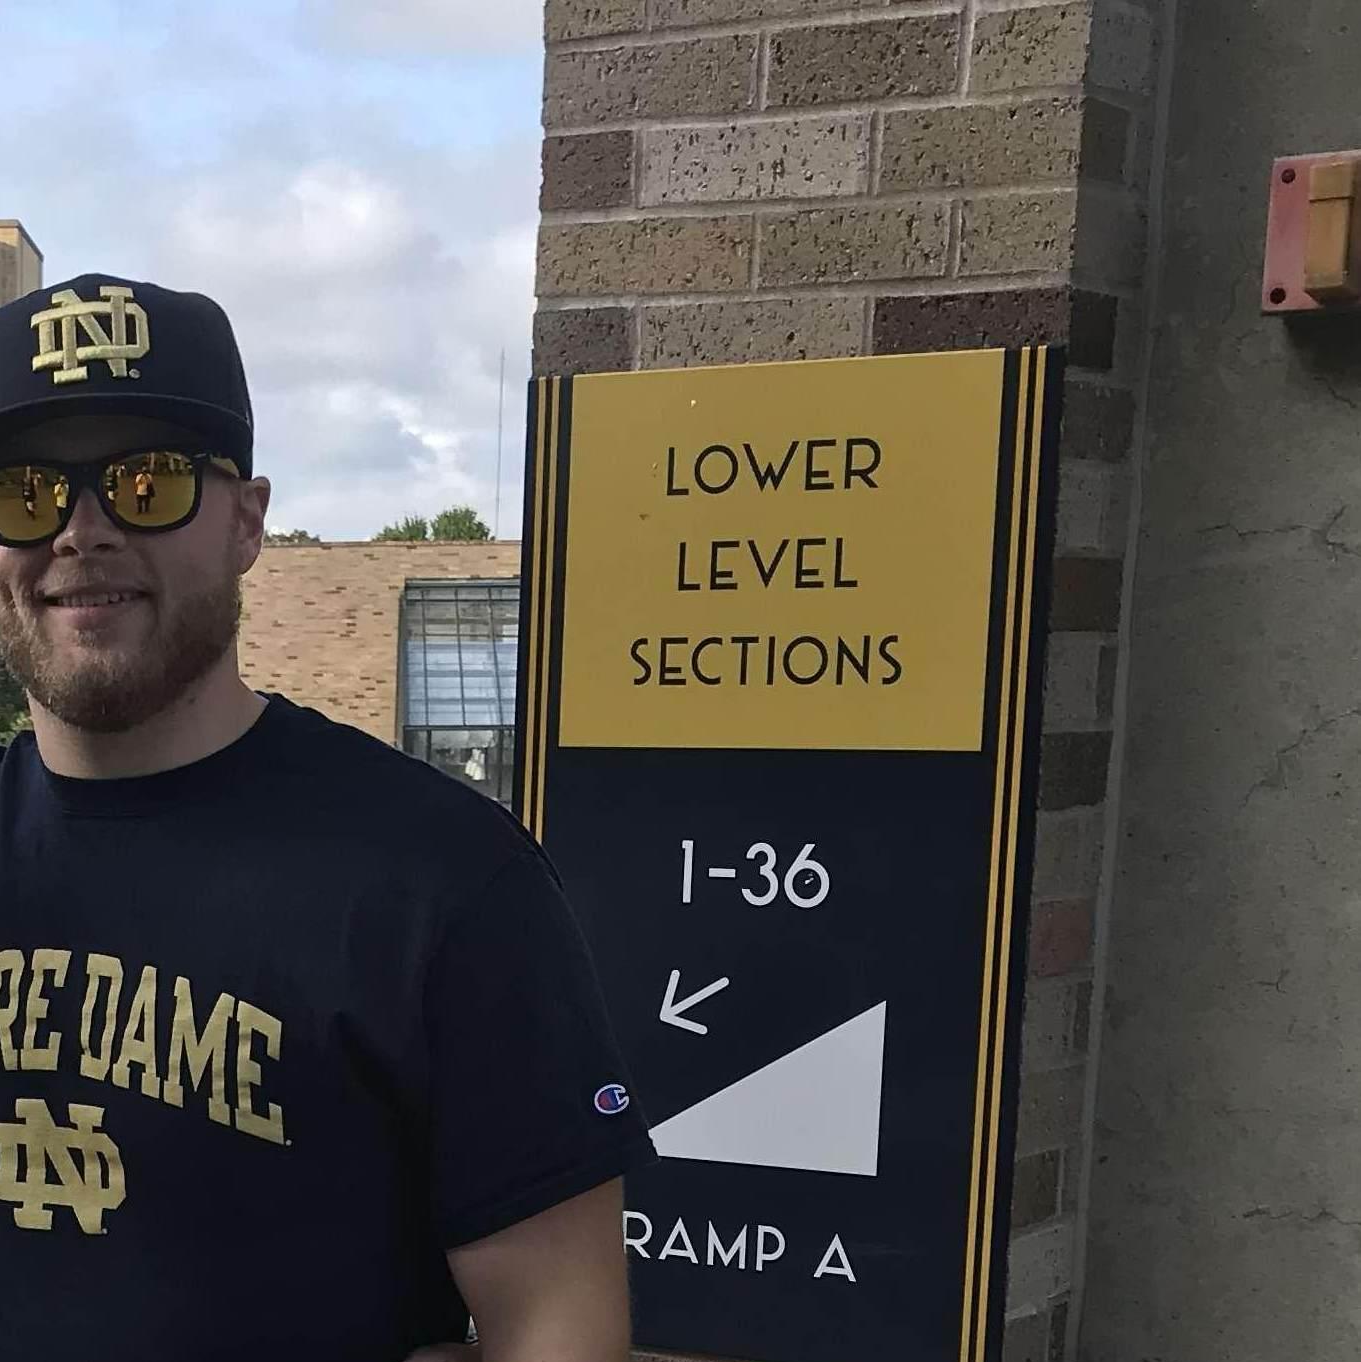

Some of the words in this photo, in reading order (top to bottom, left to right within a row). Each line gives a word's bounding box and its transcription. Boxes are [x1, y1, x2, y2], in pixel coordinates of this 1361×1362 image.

[31, 286, 150, 384] ND
[666, 438, 882, 496] LOWER
[677, 538, 859, 591] LEVEL
[630, 635, 903, 686] SECTIONS
[681, 840, 830, 908] 1-36
[80, 953, 285, 1145] DAME
[622, 1210, 786, 1271] RAMP
[813, 1233, 857, 1282] A
